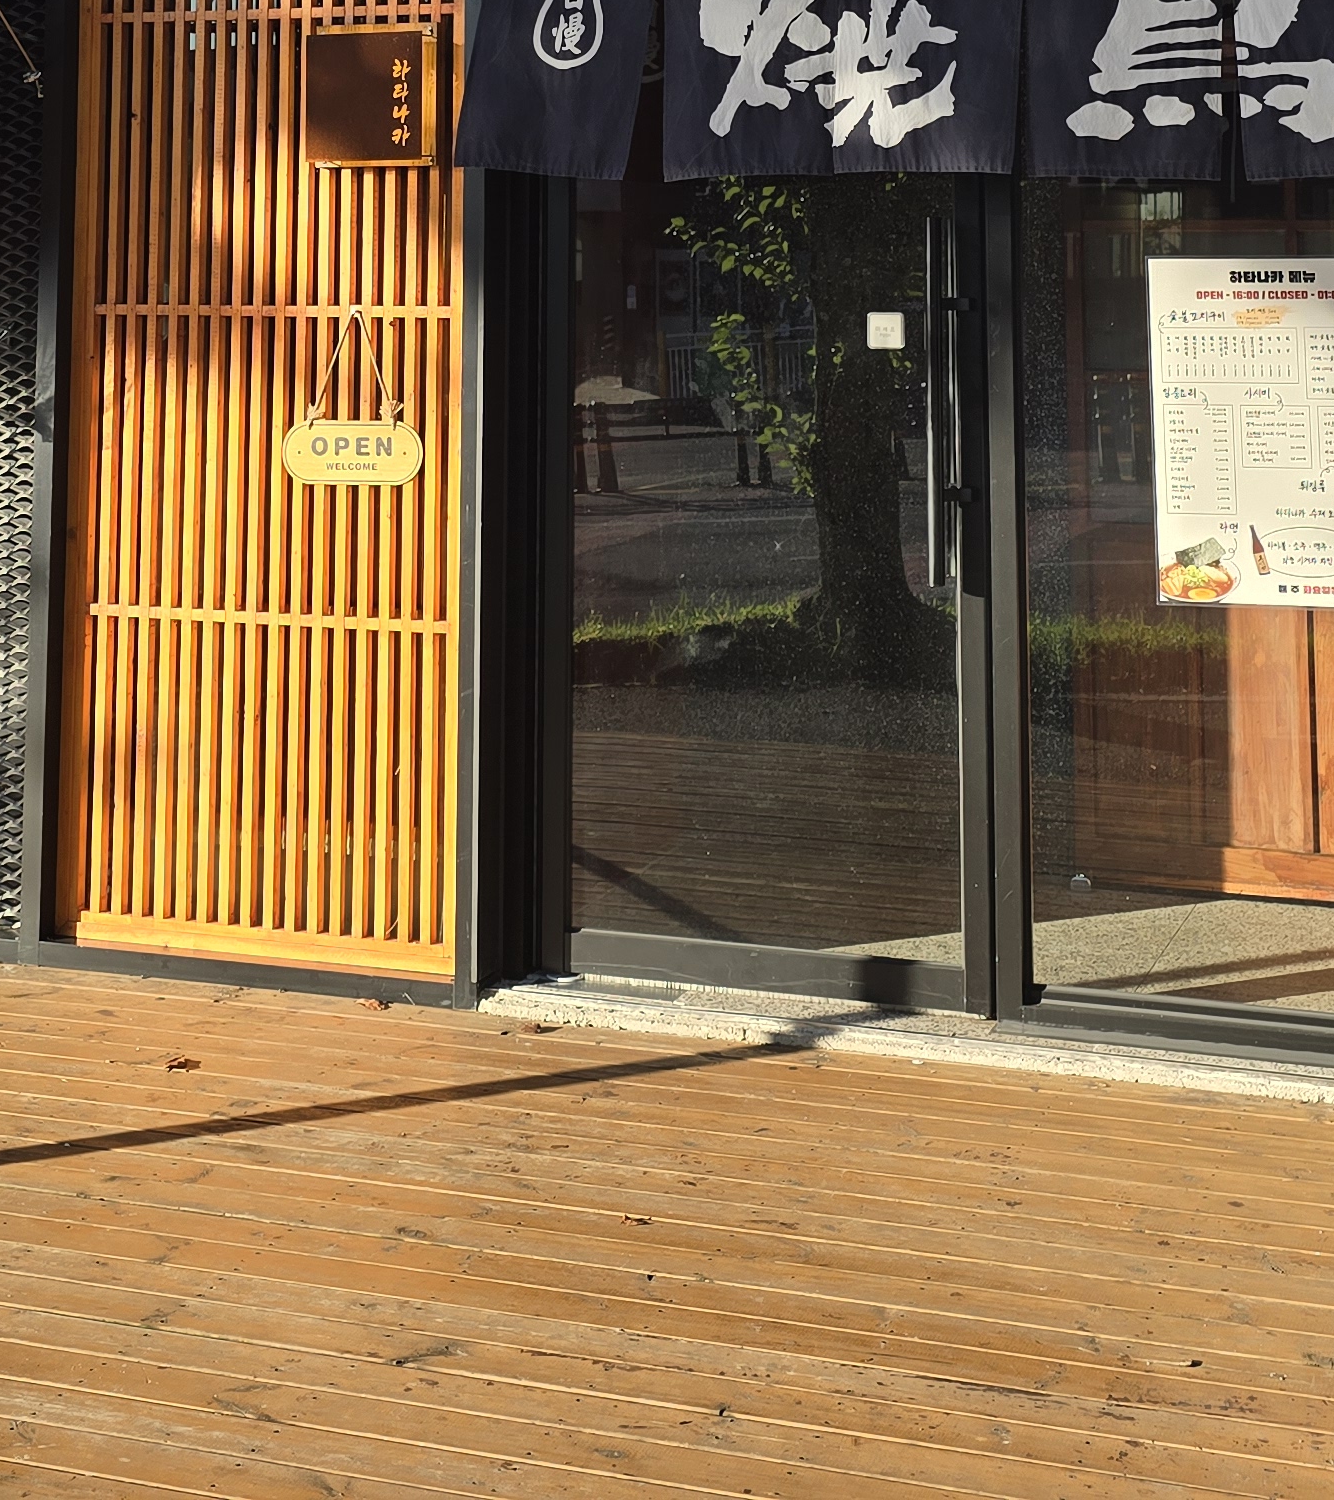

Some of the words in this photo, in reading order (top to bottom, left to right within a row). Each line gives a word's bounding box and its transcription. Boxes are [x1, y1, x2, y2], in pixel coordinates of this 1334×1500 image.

[391, 58, 411, 147] 하타나카
[1229, 270, 1284, 284] 하타나카
[1288, 270, 1316, 284] 메뉴
[1196, 290, 1224, 300] OPEN
[1232, 290, 1260, 300] 16:00
[1267, 290, 1309, 300] CLOSED
[1244, 387, 1271, 400] 사시미
[310, 435, 394, 457] OPEN
[325, 462, 379, 472] WELCOME
[1219, 521, 1239, 534] 라멘
